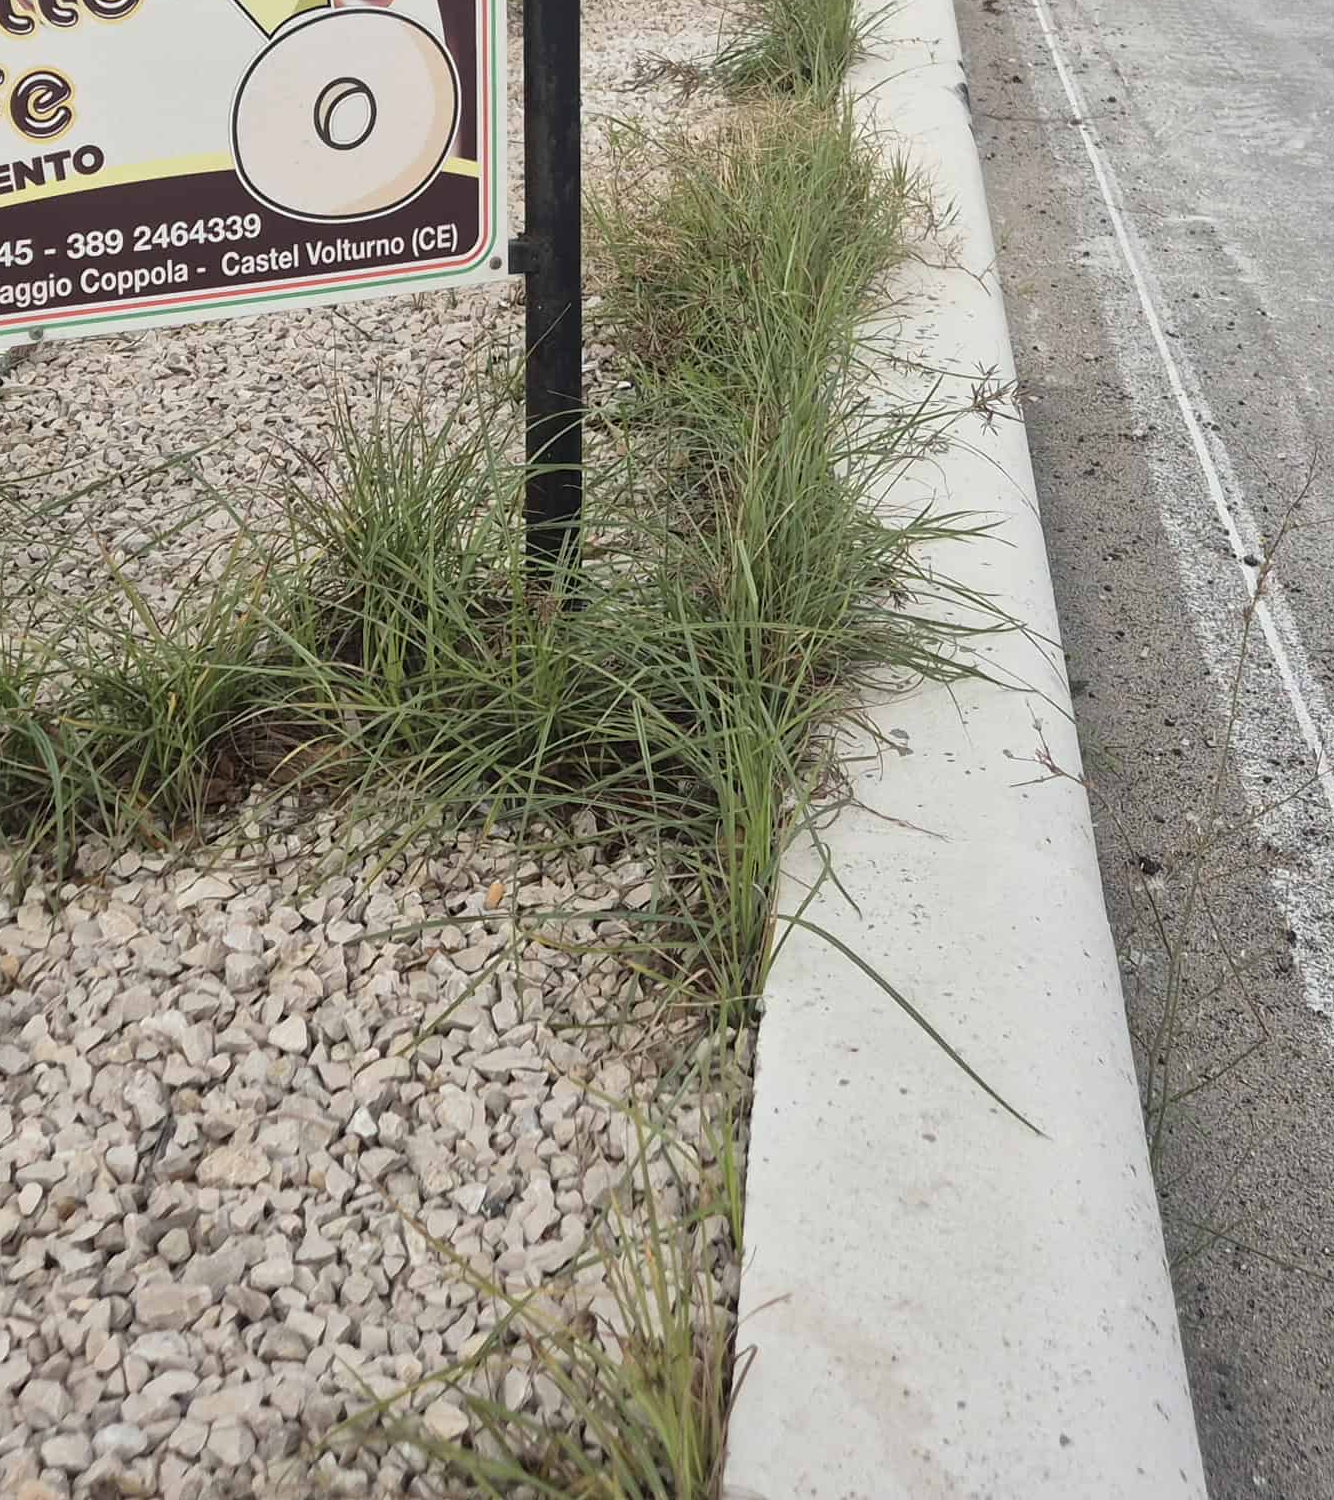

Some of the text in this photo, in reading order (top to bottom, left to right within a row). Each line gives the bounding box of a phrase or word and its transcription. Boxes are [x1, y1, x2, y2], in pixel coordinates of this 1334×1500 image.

[66, 228, 124, 261] 389
[133, 213, 263, 253] 2464339
[80, 262, 189, 300] Coppola
[221, 244, 300, 277] Castel
[306, 234, 405, 267] Volturno
[411, 223, 460, 258] (CE)
